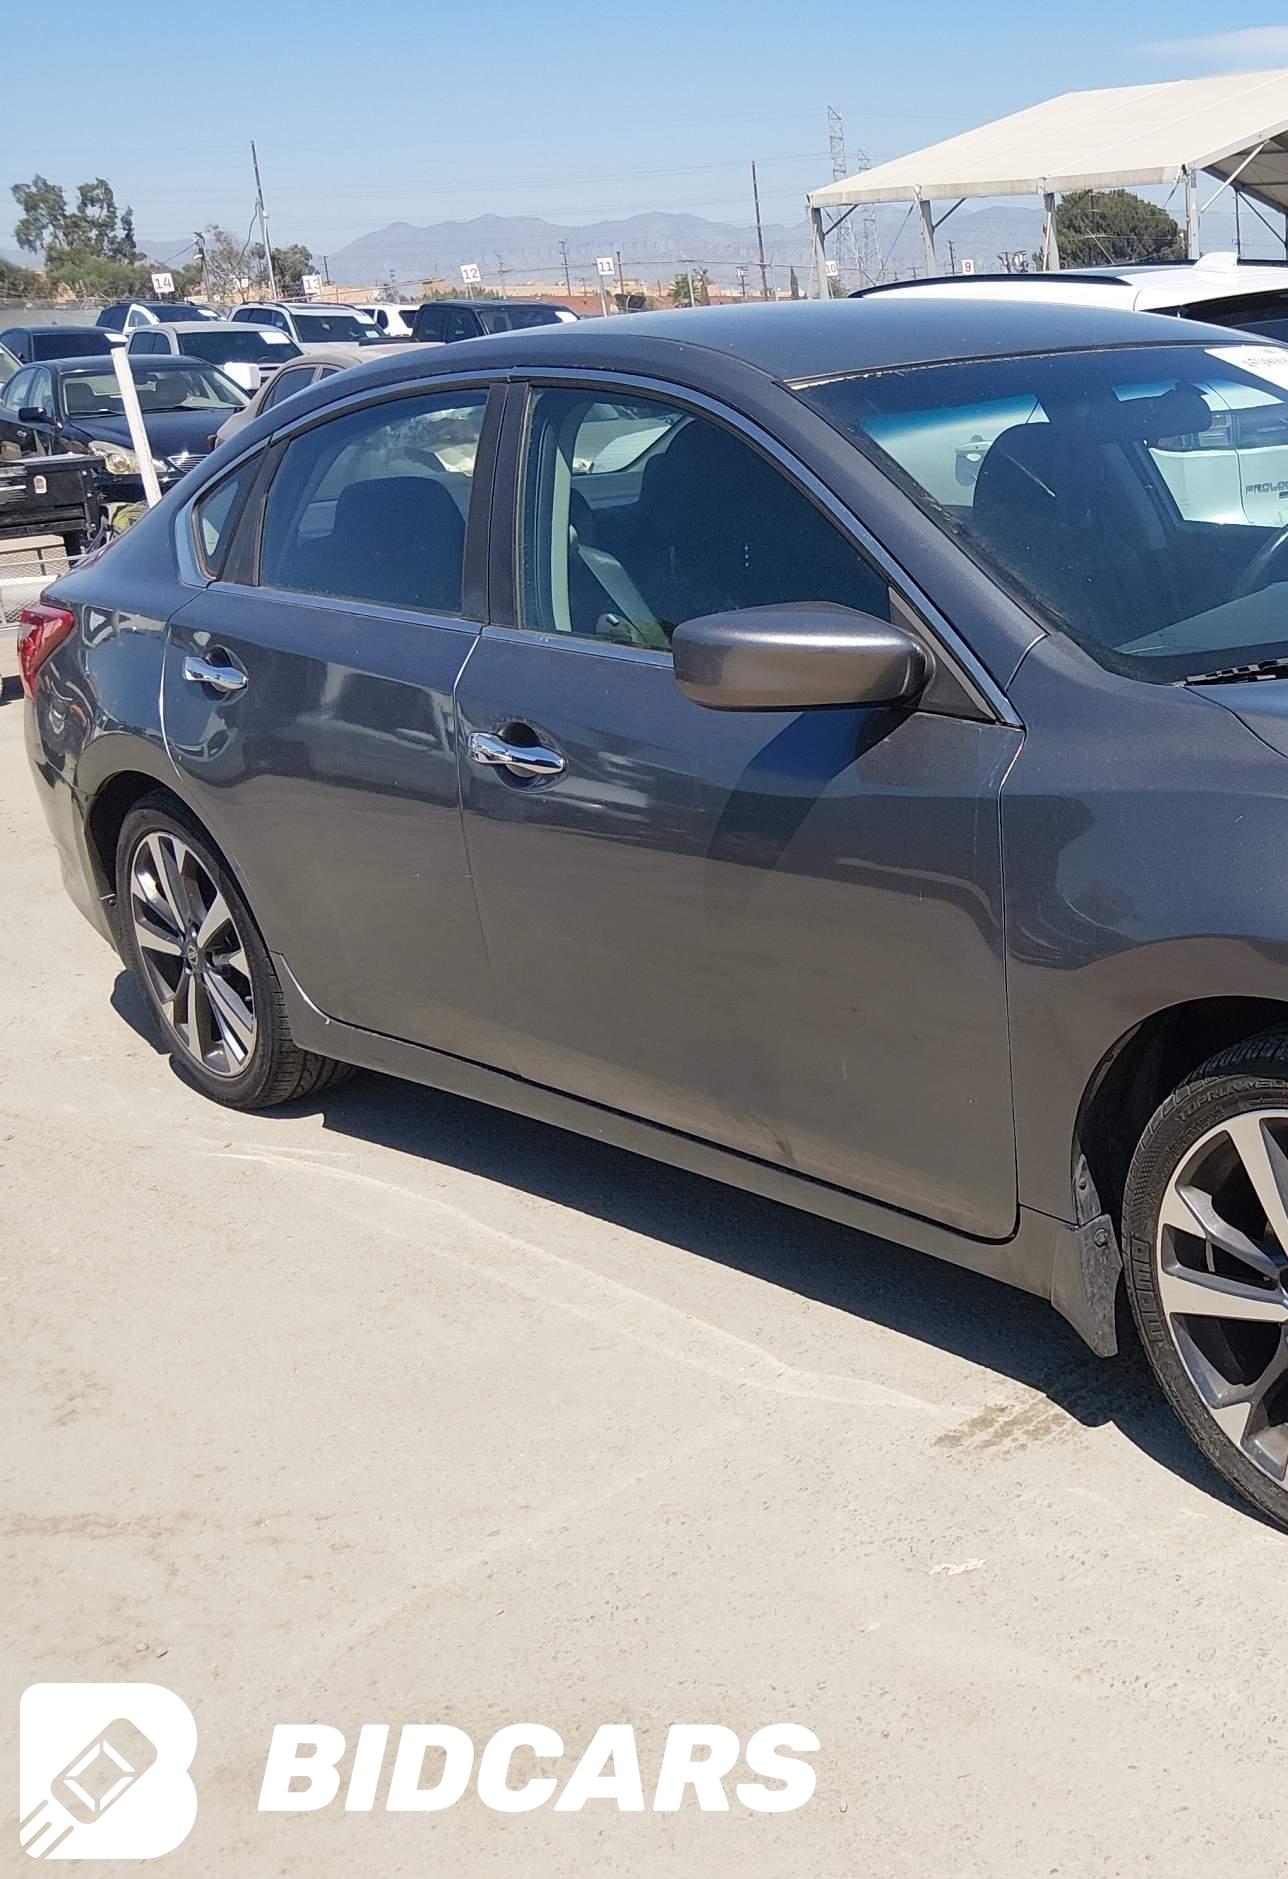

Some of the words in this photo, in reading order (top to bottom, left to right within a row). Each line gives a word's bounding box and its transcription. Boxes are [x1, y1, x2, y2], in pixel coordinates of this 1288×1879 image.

[599, 261, 613, 272] 11
[964, 261, 971, 272] 9
[462, 268, 479, 280] 12
[154, 276, 172, 290] 14
